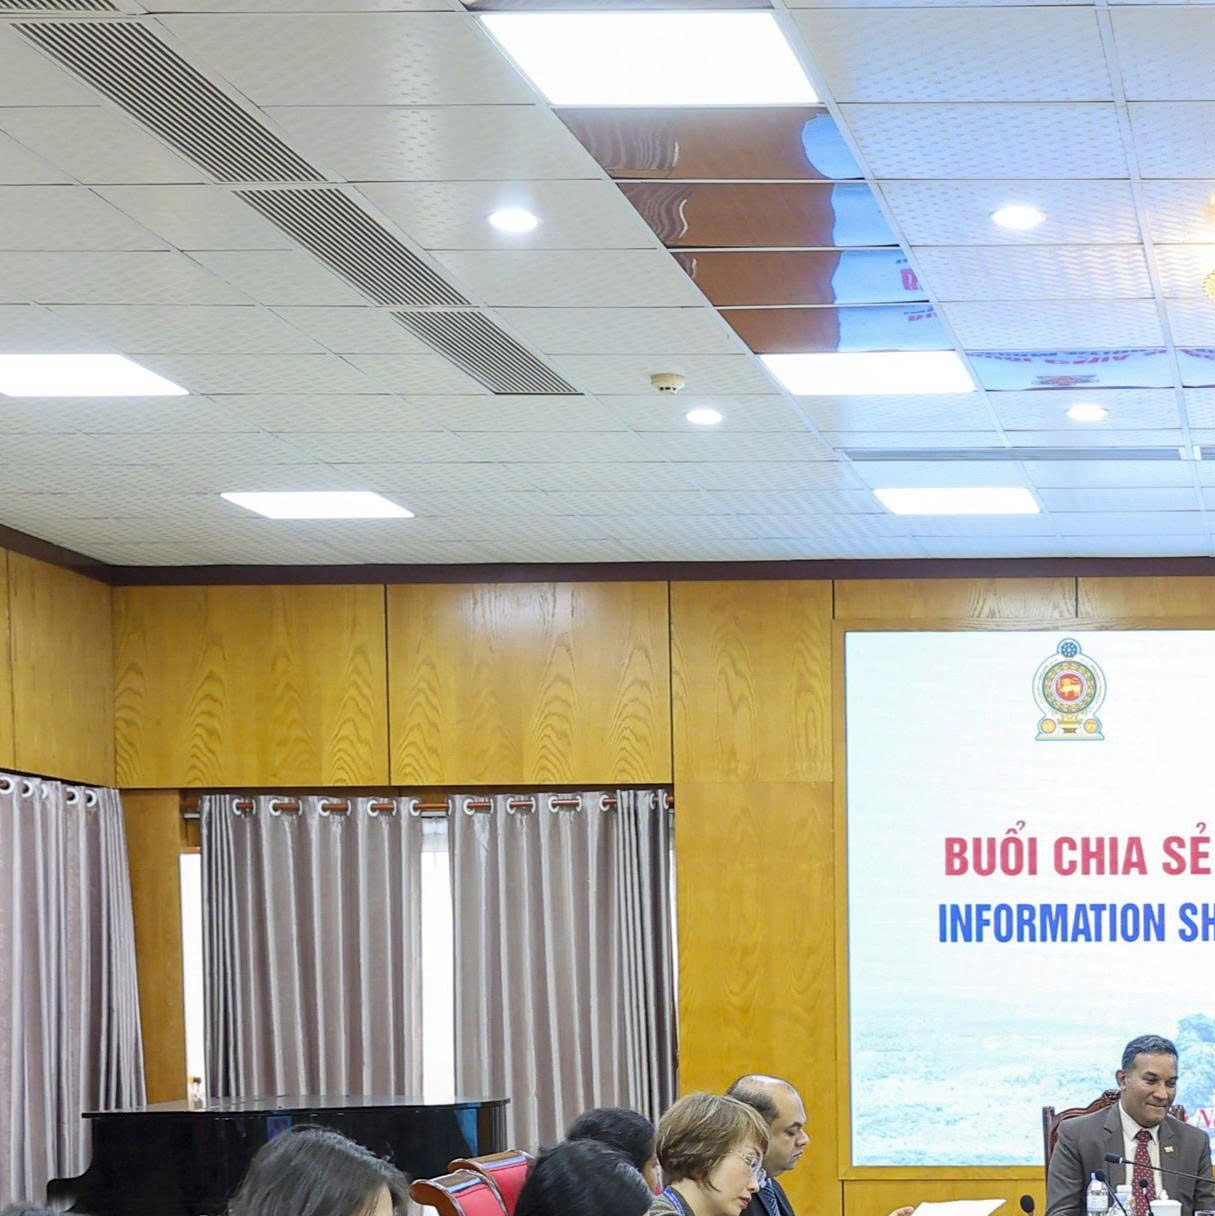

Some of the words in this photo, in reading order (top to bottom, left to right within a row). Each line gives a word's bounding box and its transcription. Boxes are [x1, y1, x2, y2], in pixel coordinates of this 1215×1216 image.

[944, 820, 1038, 877] BUỔI
[1054, 836, 1148, 877] CHIA
[1162, 821, 1212, 876] SẺ
[938, 902, 1166, 944] INFORMATION
